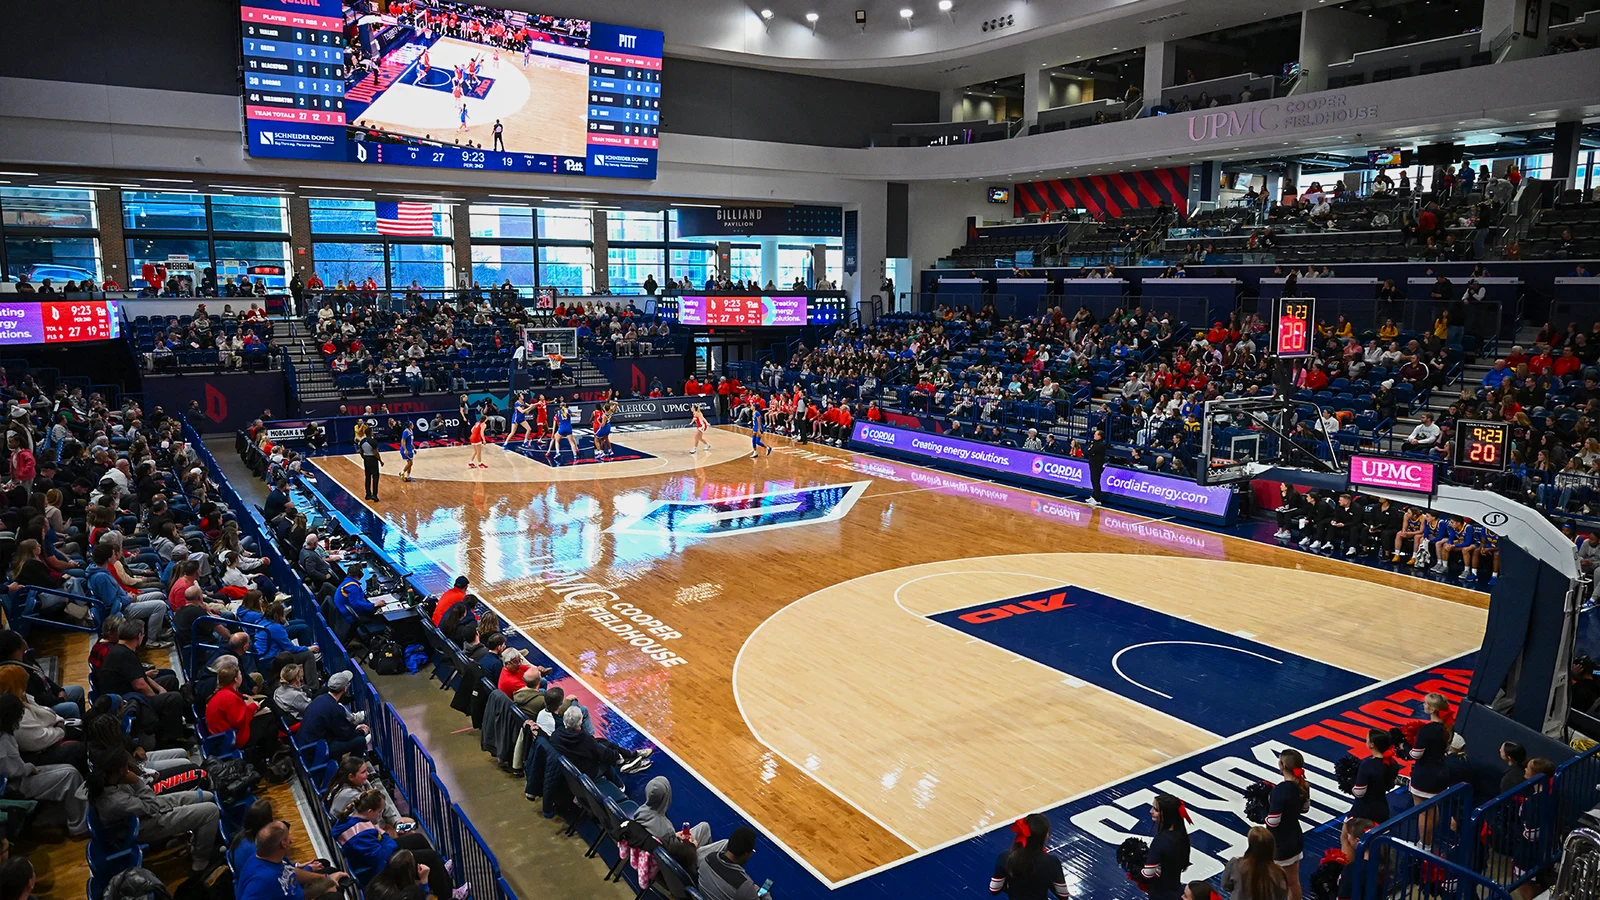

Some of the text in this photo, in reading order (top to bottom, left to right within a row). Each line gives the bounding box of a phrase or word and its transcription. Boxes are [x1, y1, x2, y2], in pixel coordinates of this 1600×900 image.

[262, 14, 286, 22] PLAYER
[248, 26, 254, 34] 3
[296, 32, 302, 40] 0
[322, 35, 328, 43] 2
[335, 36, 340, 44] 2
[619, 34, 637, 49] PITT
[249, 43, 254, 51] 7
[297, 48, 302, 56] 5
[310, 49, 316, 57] 3
[249, 60, 257, 68] 11
[298, 65, 303, 73] 5
[312, 66, 316, 74] 1
[324, 68, 329, 76] 1
[337, 85, 342, 93] 2
[250, 94, 260, 102] 44
[325, 100, 330, 108] 0
[337, 101, 343, 109] 0
[1286, 94, 1347, 114] COOPER
[338, 115, 342, 123] 5
[1188, 104, 1279, 141] UPMC
[1285, 105, 1378, 129] FIELDHOUSE
[274, 132, 335, 142] SCHNEIDER DOWNS
[432, 152, 445, 162] 27
[462, 151, 485, 162] 9:23
[502, 157, 513, 167] 19
[564, 158, 584, 172] Pitt
[716, 209, 762, 220] GILLIAND
[724, 299, 741, 307] 9:23
[0, 307, 25, 318] ting
[71, 305, 92, 316] 9:23
[1295, 305, 1308, 319] 23
[720, 315, 730, 323] 27
[0, 330, 32, 339] tions.
[68, 326, 81, 337] 27
[87, 326, 97, 336] 19
[662, 403, 690, 413] UPMC
[270, 428, 294, 437] MORGAN
[295, 428, 299, 436] &
[869, 430, 895, 443] CORDIA
[1473, 428, 1503, 444] 9:23
[912, 438, 942, 454] Creating
[943, 446, 971, 460] energy
[971, 450, 1009, 466] solutions.
[1470, 443, 1496, 462] 20
[1044, 462, 1083, 479] CORDIA
[1362, 460, 1422, 481] UPMC
[1106, 475, 1208, 504] CordiaEnergy.com
[611, 602, 683, 641] COOPER
[582, 605, 688, 668] FIELDHOUSE
